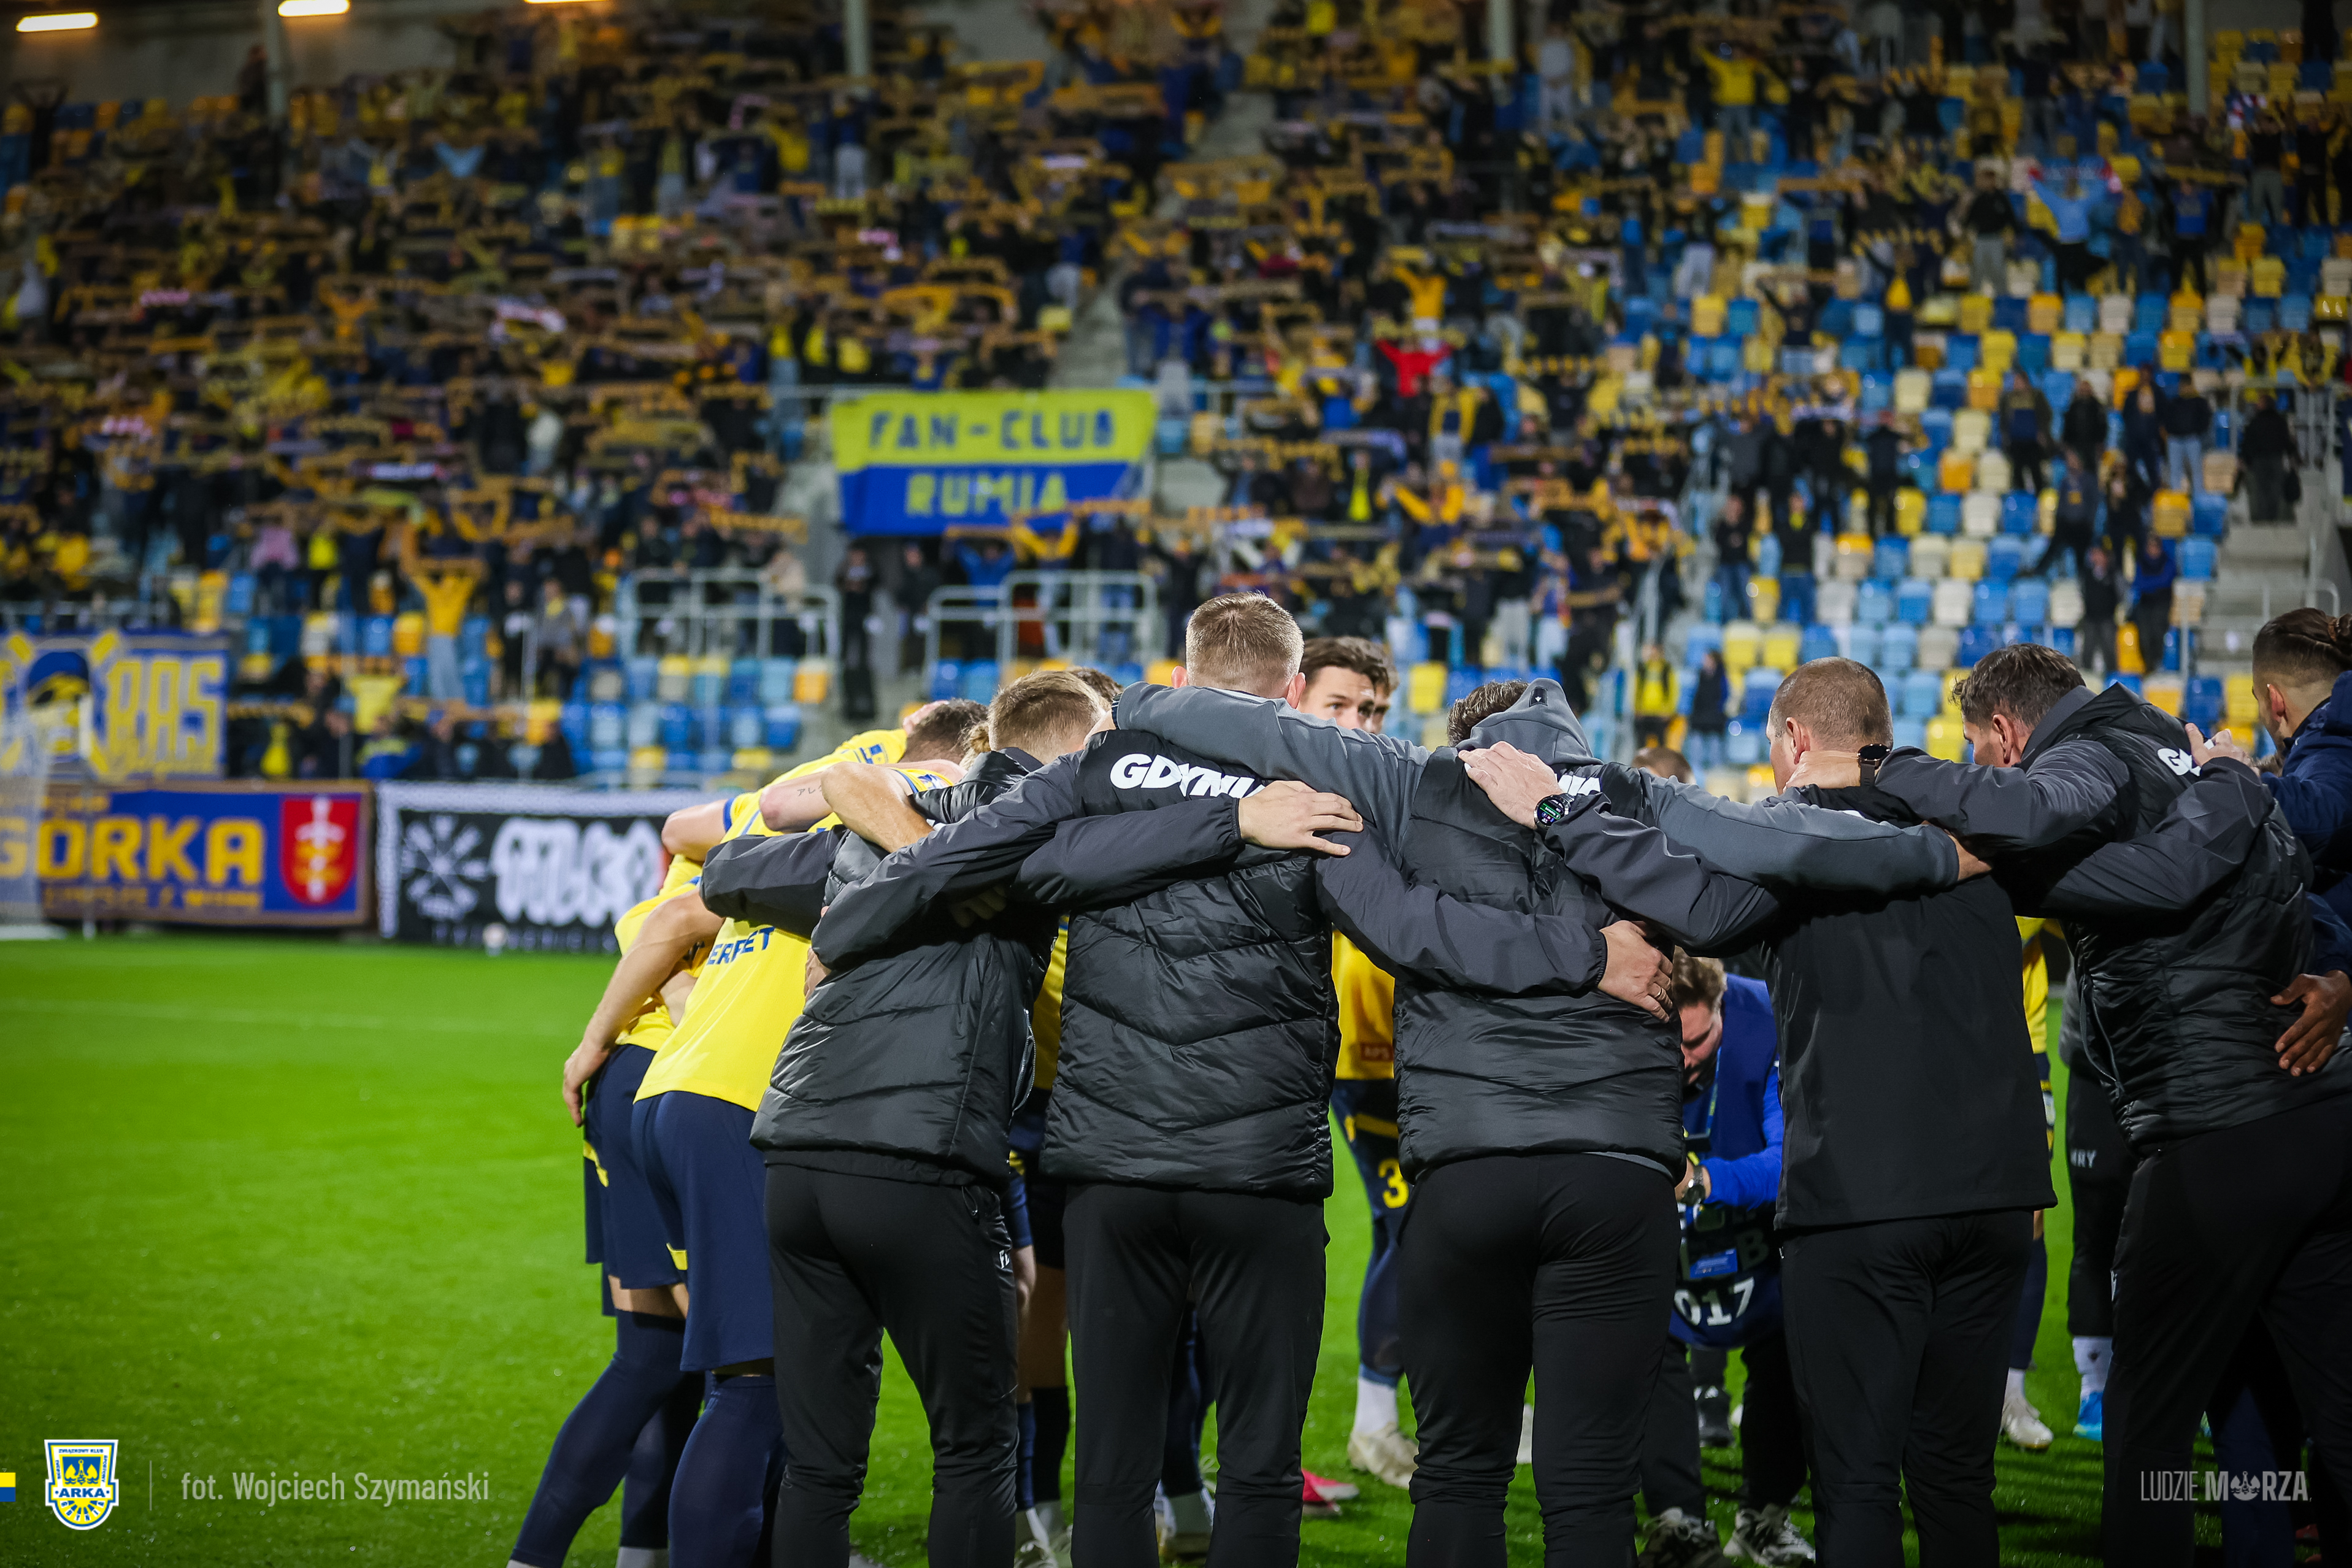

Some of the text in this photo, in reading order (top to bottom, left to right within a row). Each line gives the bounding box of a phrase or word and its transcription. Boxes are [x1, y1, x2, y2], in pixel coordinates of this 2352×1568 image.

[905, 472, 1069, 517] RUMIA
[1109, 753, 1266, 799] GDYNI
[1674, 1276, 1755, 1326] 017
